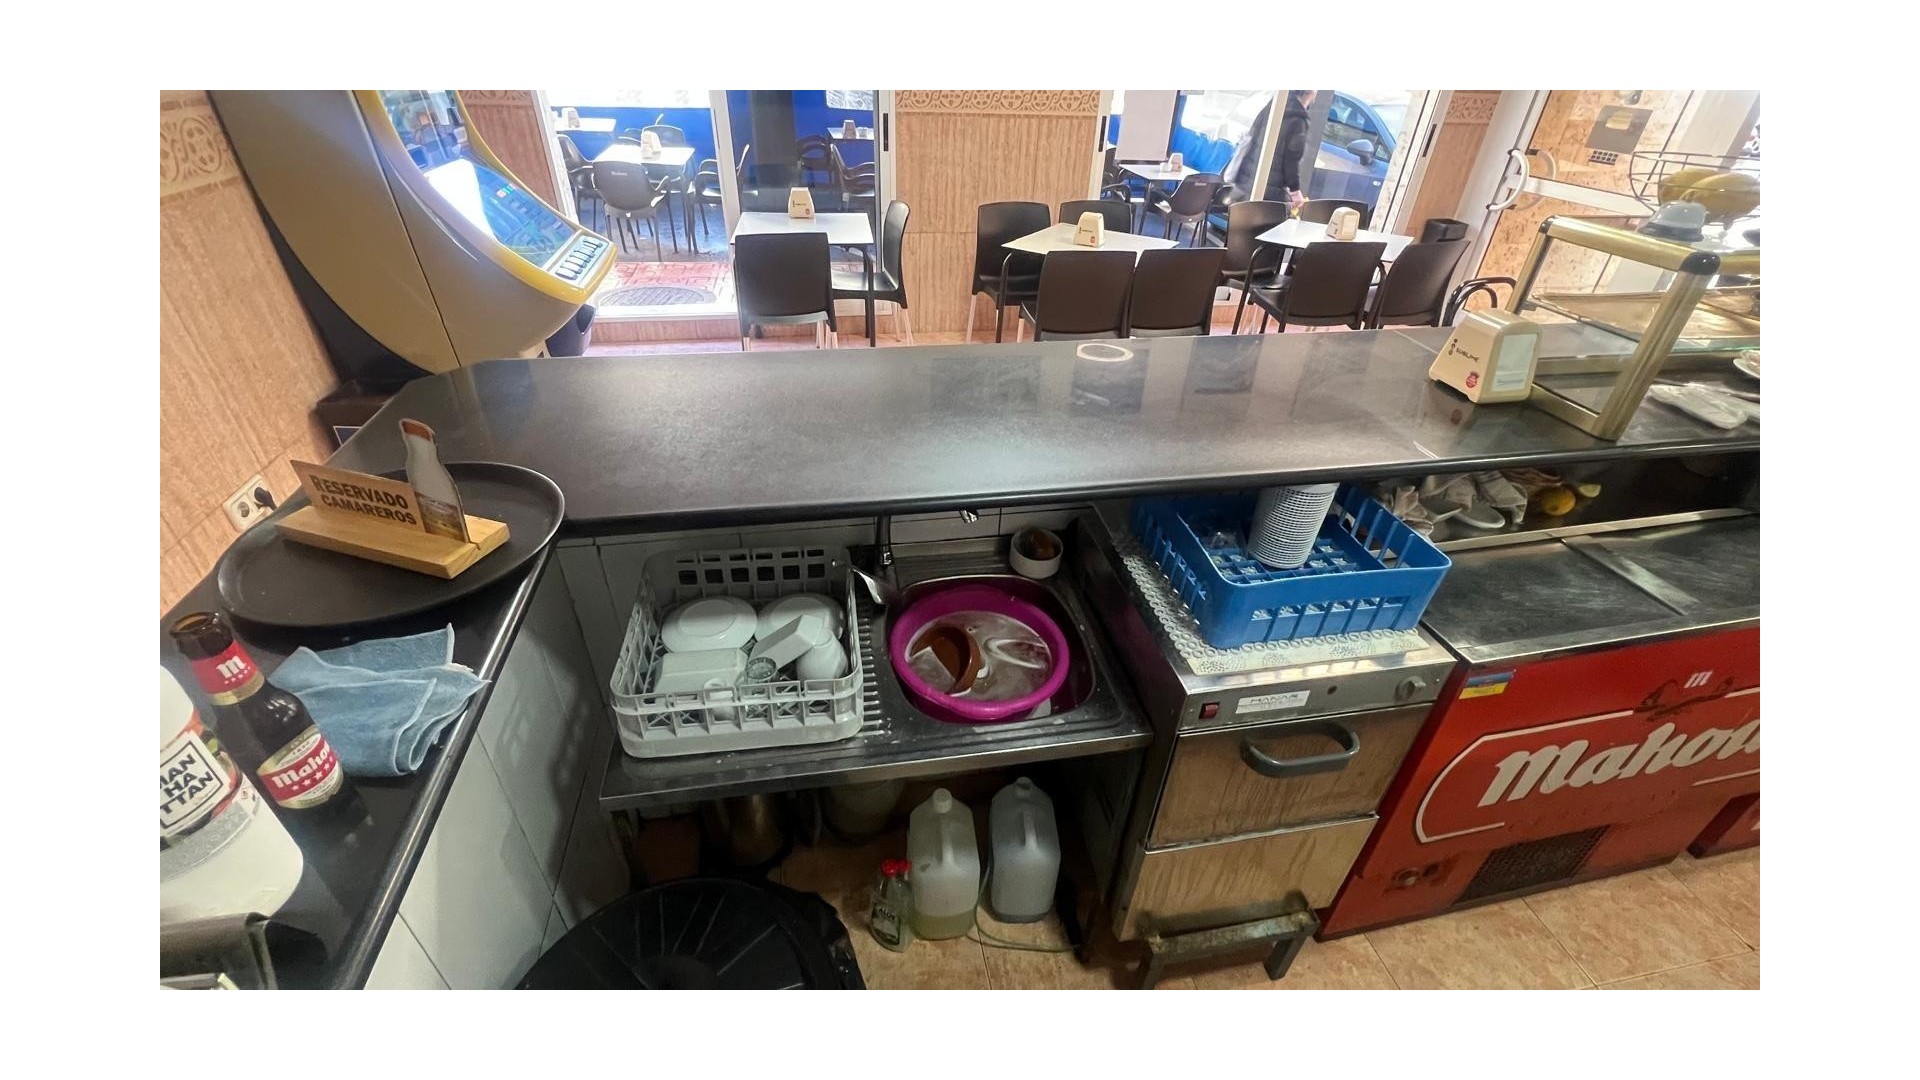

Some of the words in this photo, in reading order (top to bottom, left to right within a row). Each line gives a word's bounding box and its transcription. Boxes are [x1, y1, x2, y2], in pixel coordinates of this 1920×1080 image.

[309, 474, 409, 510] RESERVADO
[320, 494, 417, 525] CAMAREROS
[163, 772, 198, 799] HA
